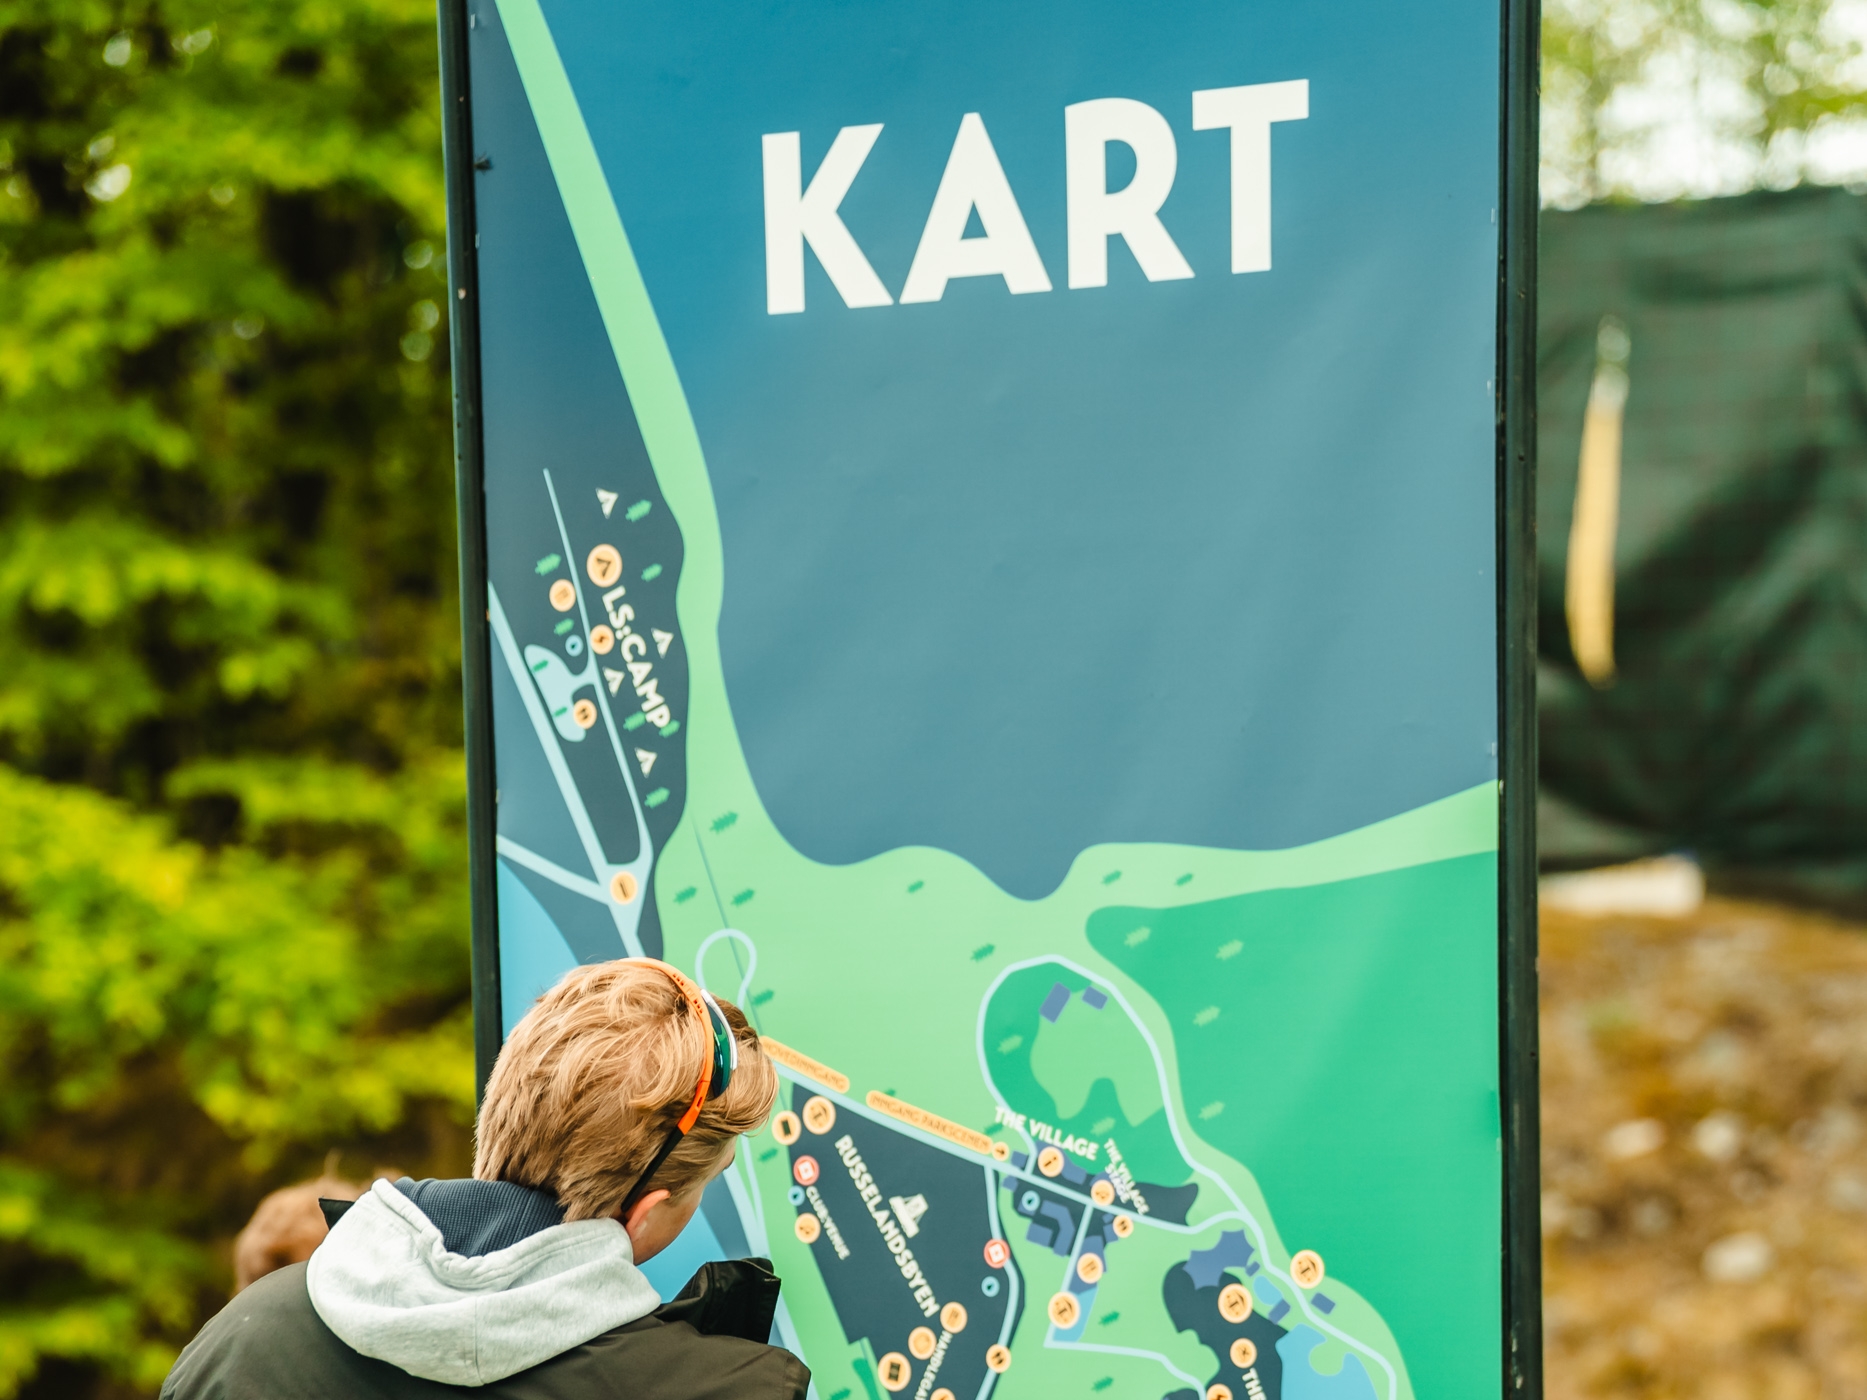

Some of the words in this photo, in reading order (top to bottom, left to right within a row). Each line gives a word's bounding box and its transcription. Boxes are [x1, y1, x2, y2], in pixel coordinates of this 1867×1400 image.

[761, 78, 1310, 315] KART
[602, 585, 671, 729] LS:CAMP
[995, 1106, 1027, 1129] THE
[1030, 1119, 1099, 1161] VILLAGE
[835, 1135, 940, 1318] RUSSELANDSBYEN
